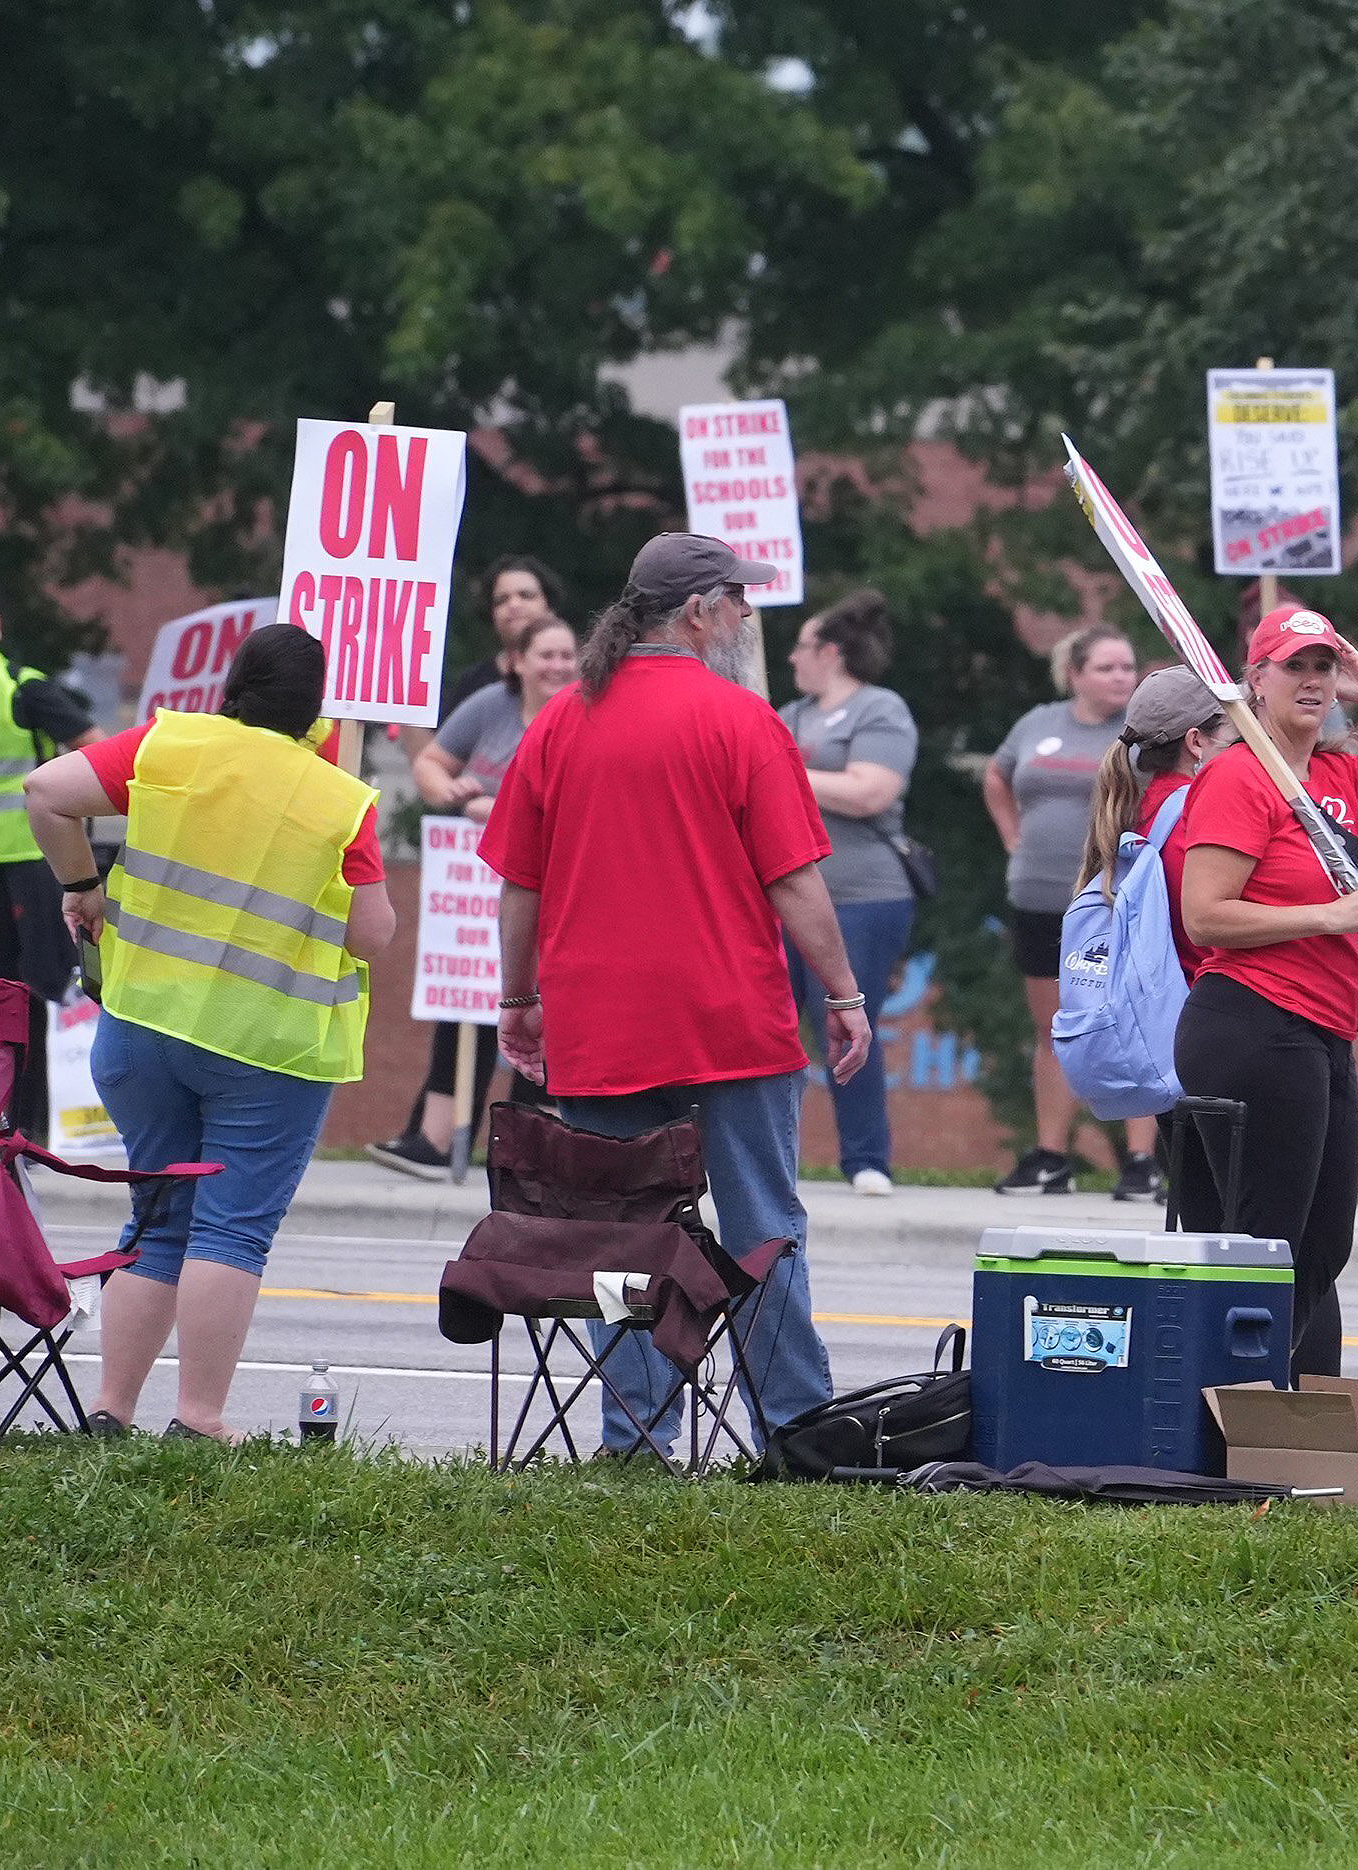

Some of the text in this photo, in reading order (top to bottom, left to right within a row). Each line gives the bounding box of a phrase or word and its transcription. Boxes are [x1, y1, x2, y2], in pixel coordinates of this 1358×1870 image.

[685, 409, 781, 440] ON STRIKE
[319, 429, 429, 562] ON
[692, 475, 788, 505] SCHOOLS
[731, 538, 794, 561] DENTS
[170, 610, 256, 681] ON
[428, 826, 457, 850] ON
[447, 862, 500, 884] FOR TH
[428, 890, 499, 919] SCHOO
[456, 927, 490, 946] OUR
[423, 951, 499, 979] STUDEN
[425, 984, 500, 1011] DESERV
[1041, 1302, 1111, 1315] Transformer
